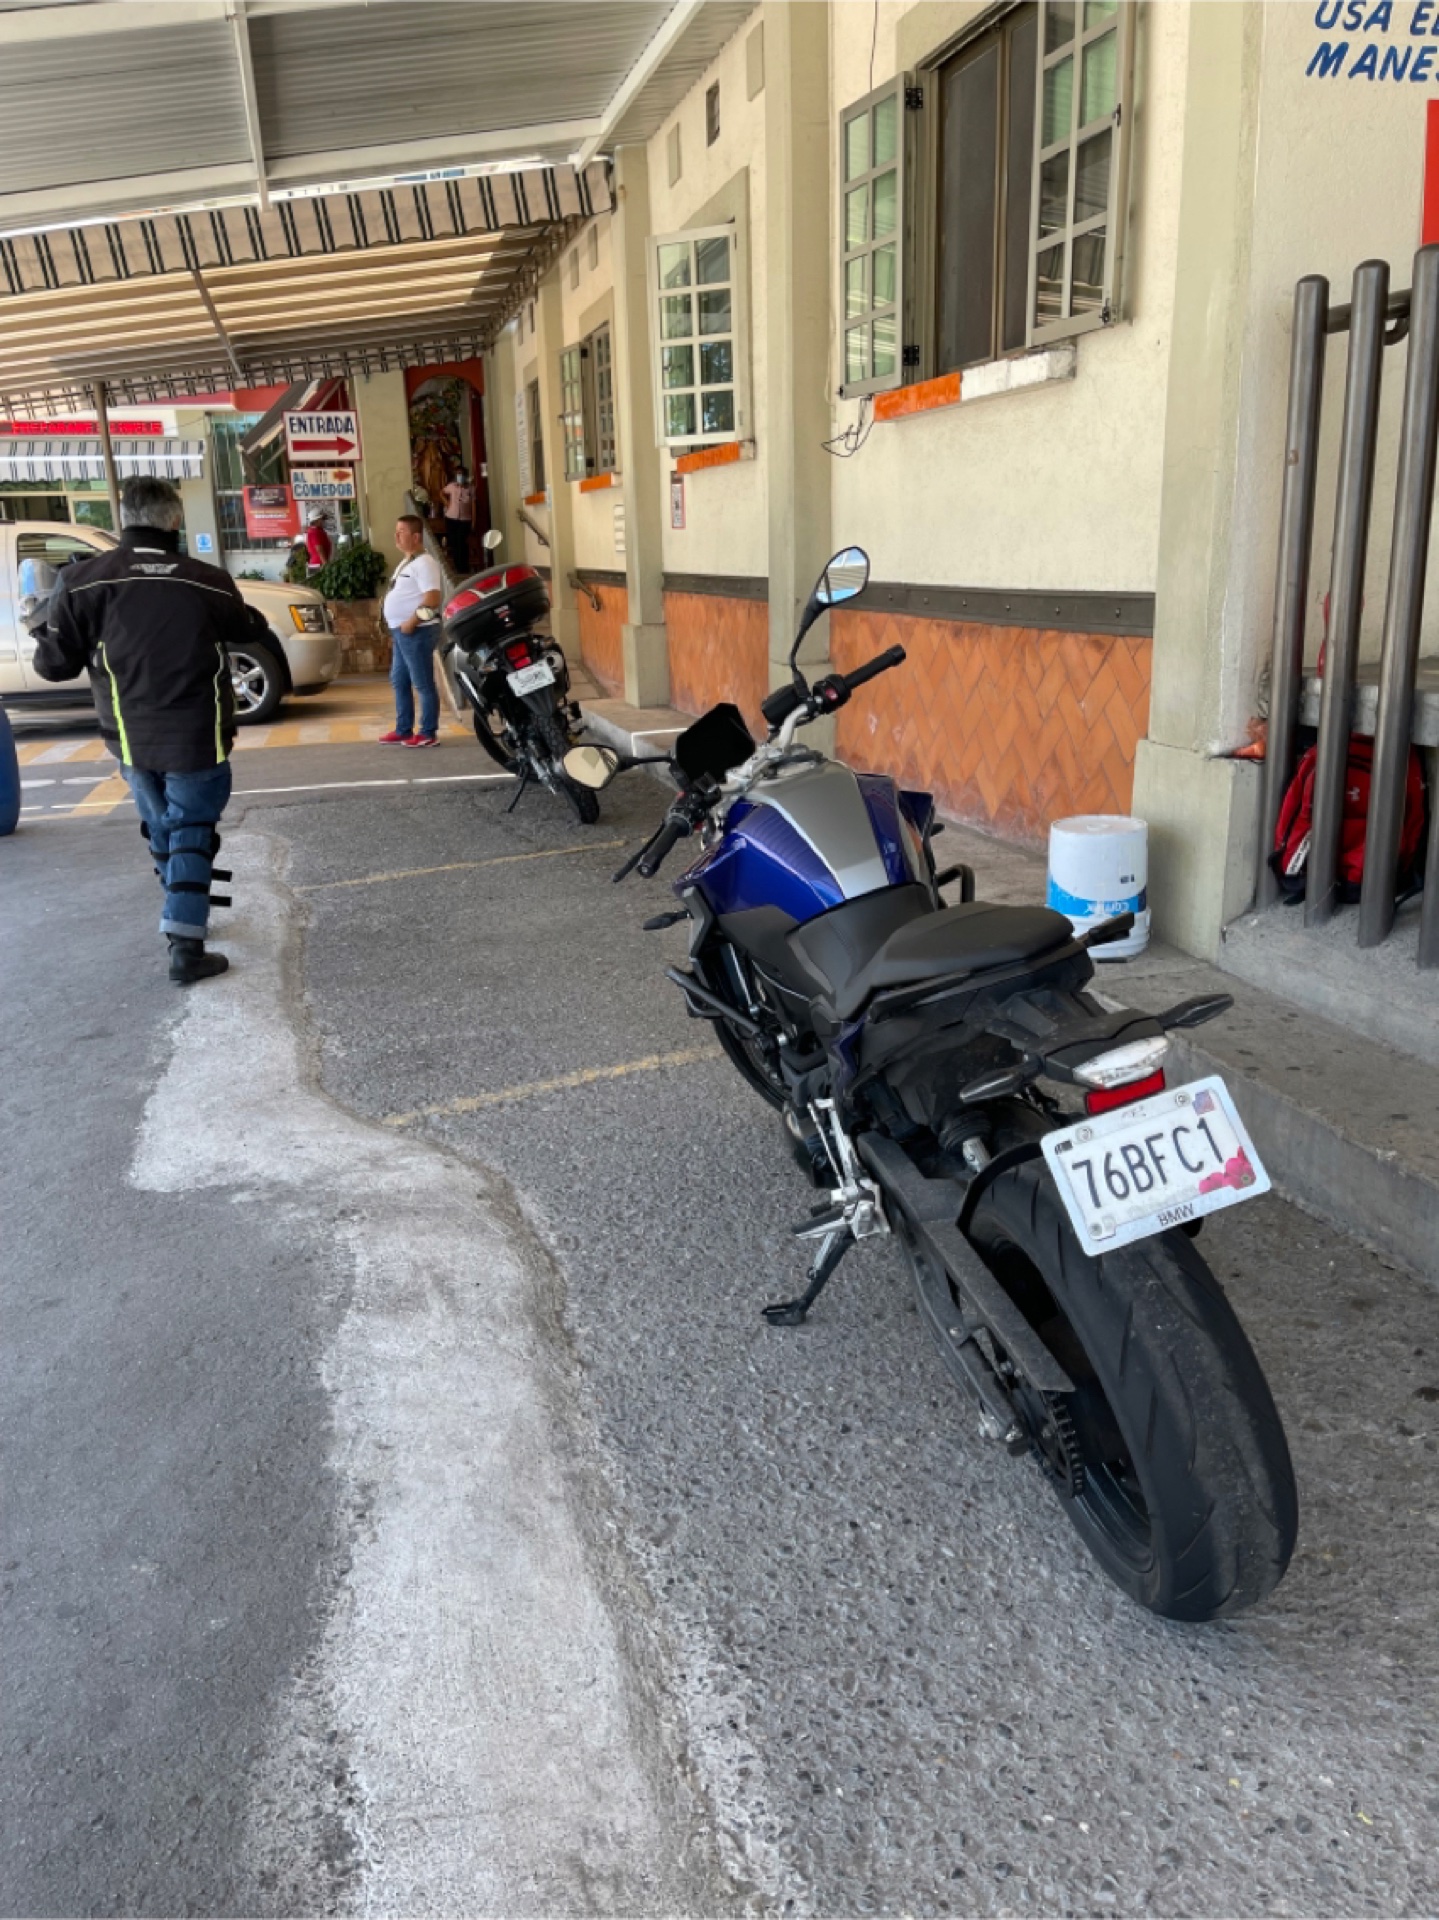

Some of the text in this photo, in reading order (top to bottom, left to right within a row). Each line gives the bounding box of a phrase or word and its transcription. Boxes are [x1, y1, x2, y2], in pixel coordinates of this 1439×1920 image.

[1314, 0, 1393, 32] USA
[1304, 41, 1439, 83] MANE
[288, 415, 355, 435] ENTRADA
[292, 471, 307, 483] AL
[293, 483, 353, 497] COMEDOR
[1072, 1117, 1223, 1209] 76BFC1
[1157, 1203, 1195, 1227] BMW
